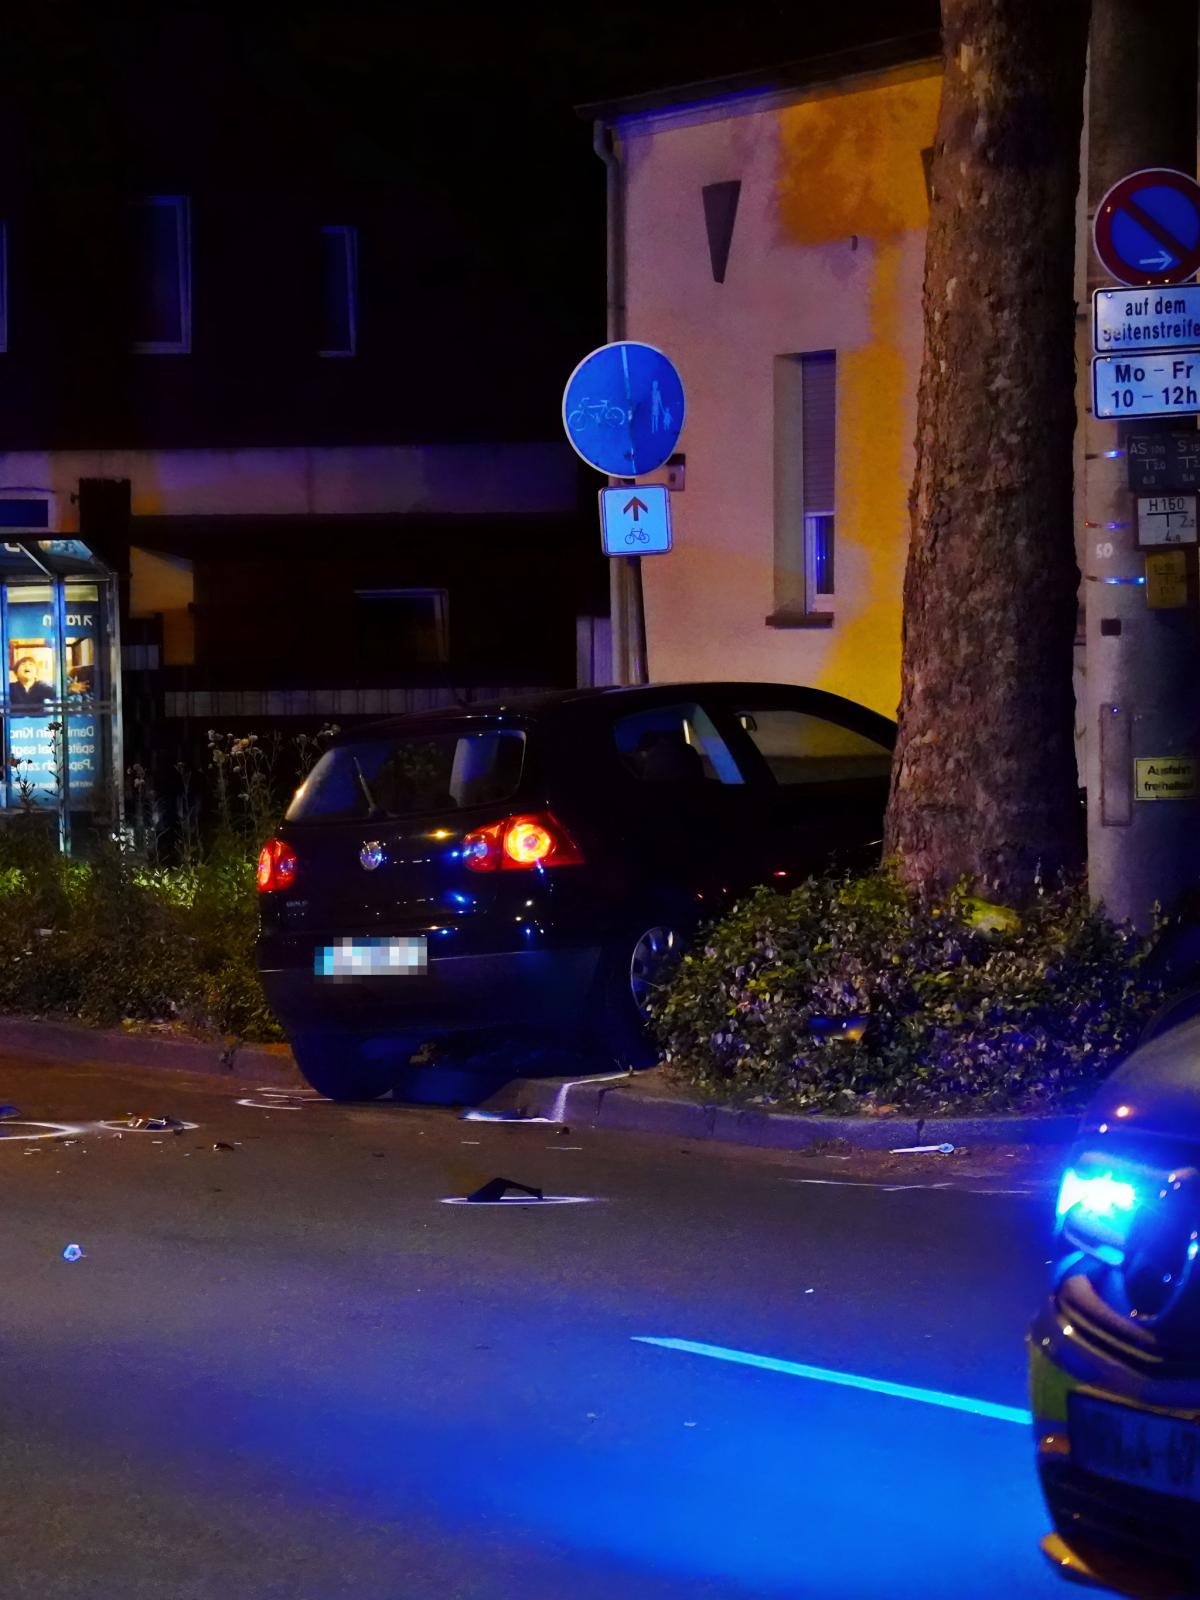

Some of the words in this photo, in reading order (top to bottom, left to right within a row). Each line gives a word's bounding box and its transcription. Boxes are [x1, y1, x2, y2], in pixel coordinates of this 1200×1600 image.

[1125, 297, 1149, 316] auf
[1154, 296, 1186, 315] dem
[1114, 364, 1145, 383] Mo
[1172, 361, 1194, 379] Fr
[1111, 390, 1134, 408] 10
[1161, 386, 1197, 405] 12h
